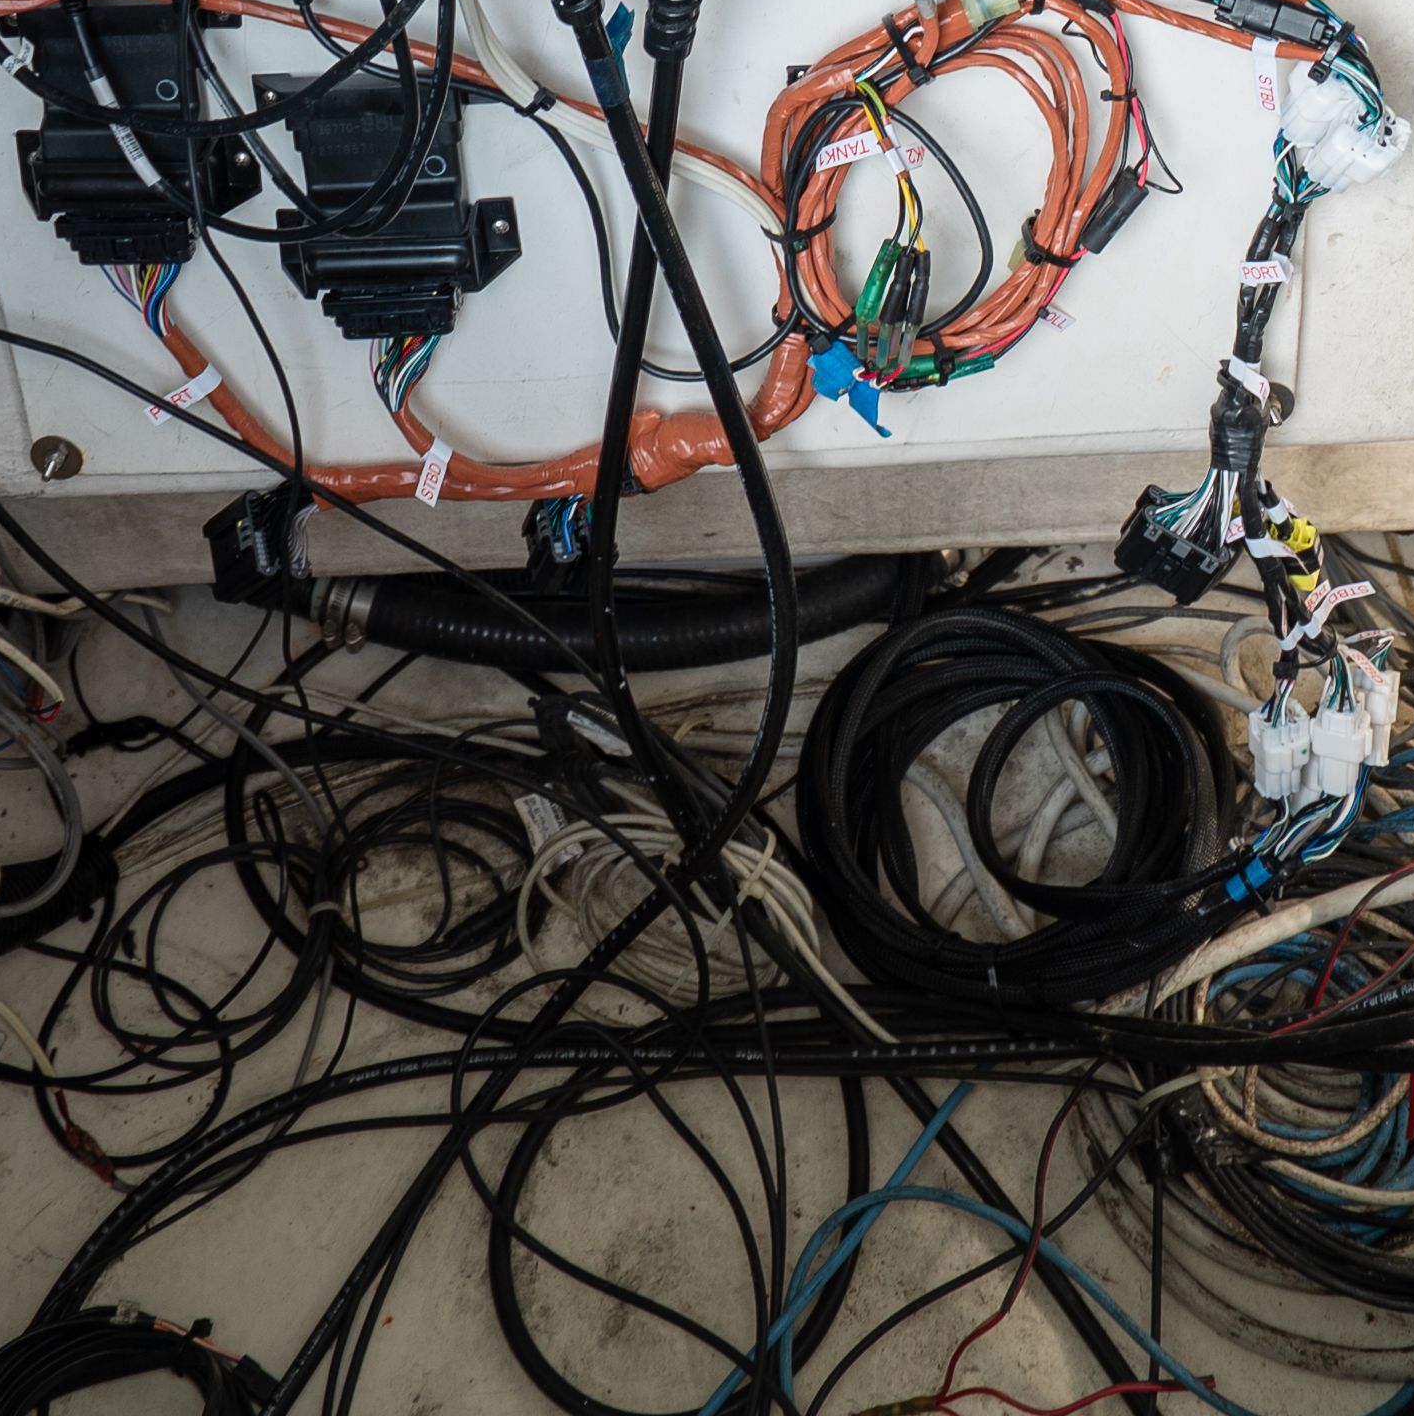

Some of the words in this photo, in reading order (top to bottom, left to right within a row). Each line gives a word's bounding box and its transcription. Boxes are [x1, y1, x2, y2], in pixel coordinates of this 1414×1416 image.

[1258, 74, 1277, 112] STBD
[818, 138, 871, 168] TANK1
[1242, 266, 1280, 280] PORT
[150, 389, 194, 420] PRT
[421, 463, 443, 501] STBD
[1328, 584, 1371, 606] STBD
